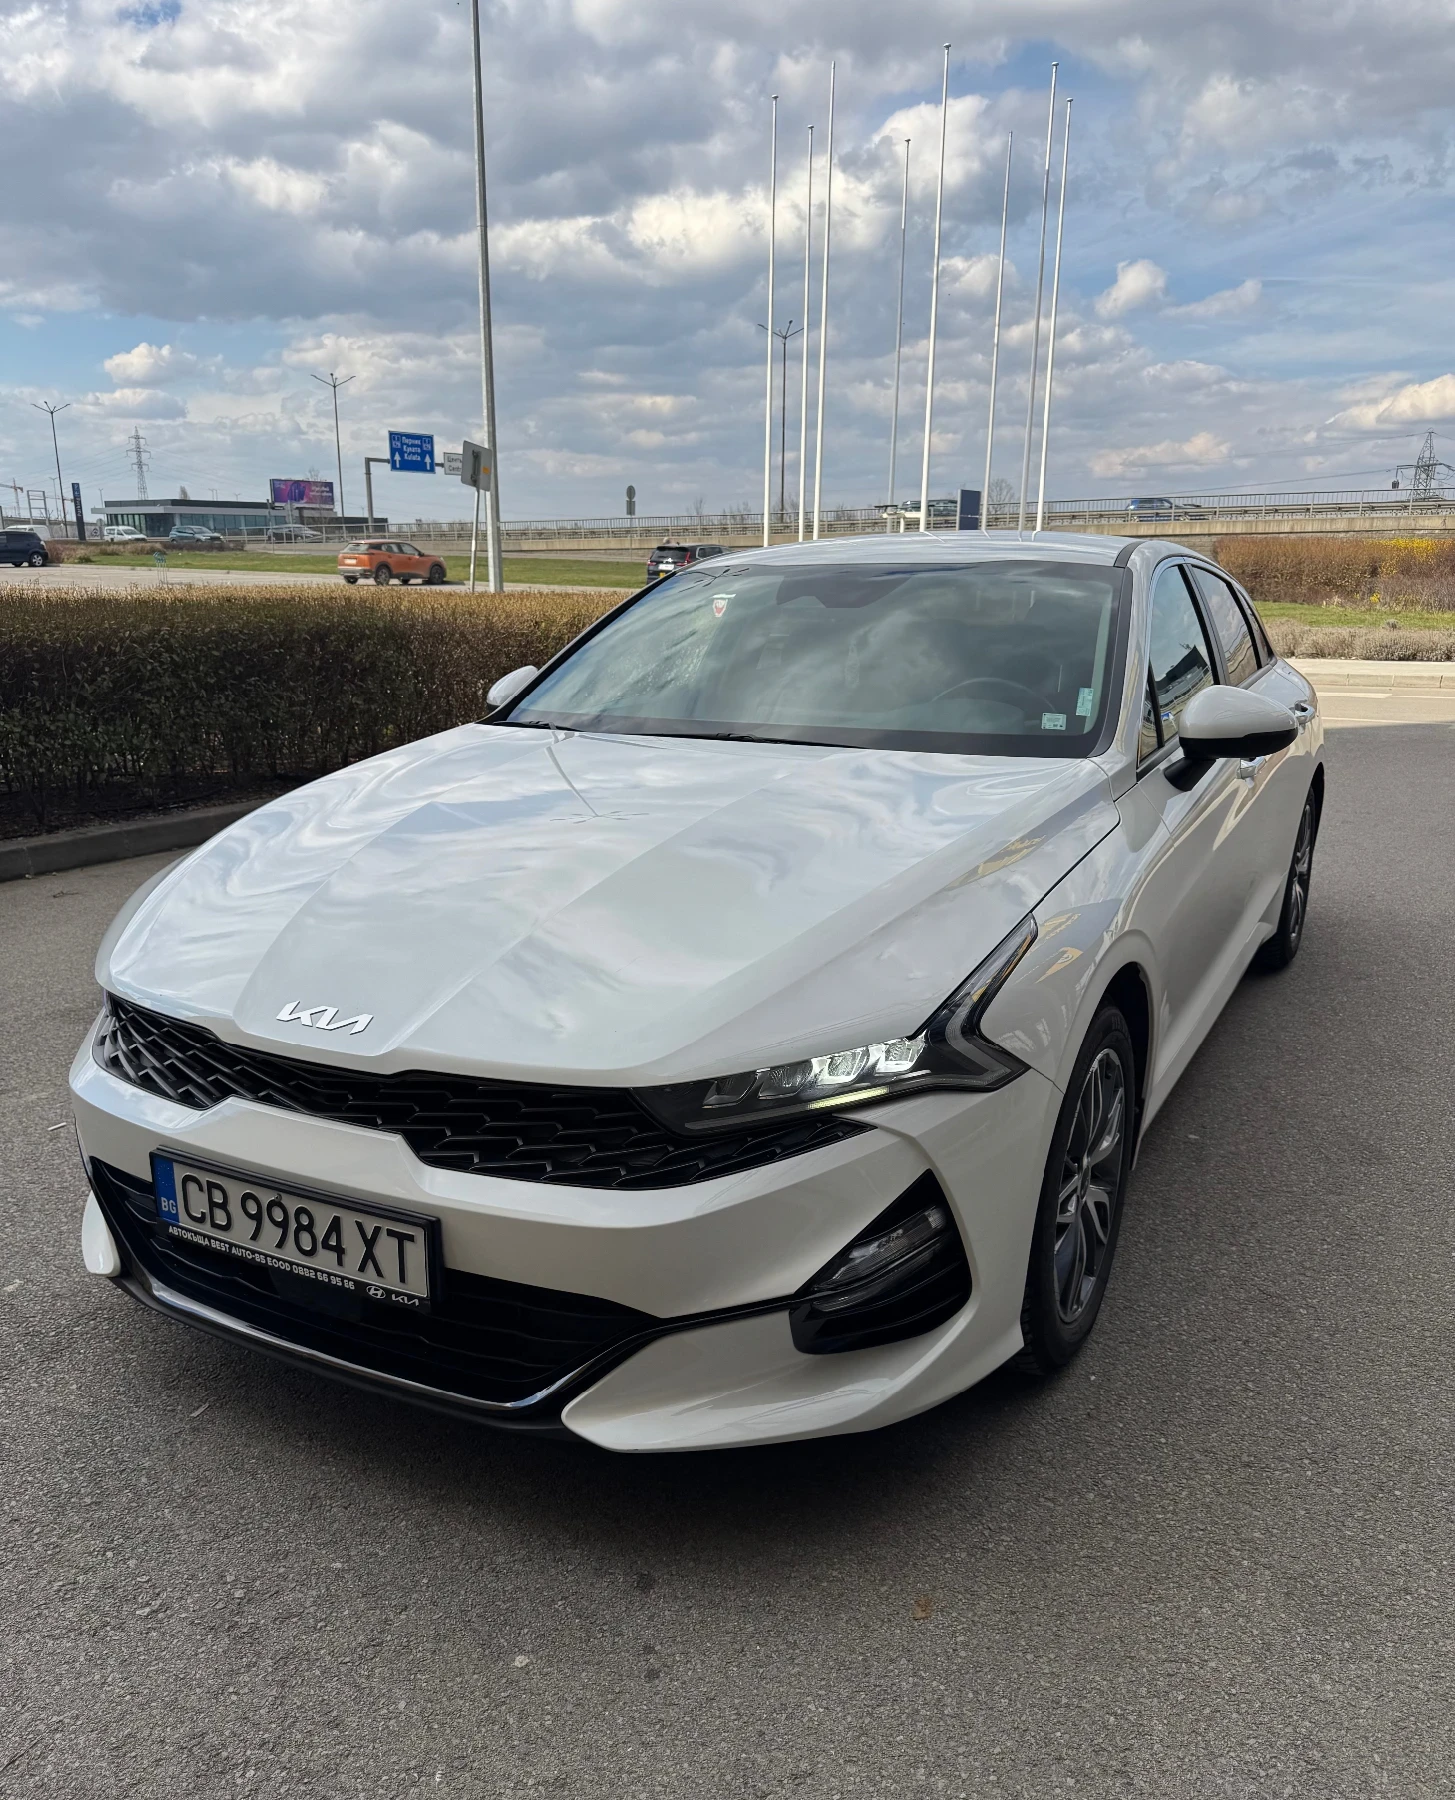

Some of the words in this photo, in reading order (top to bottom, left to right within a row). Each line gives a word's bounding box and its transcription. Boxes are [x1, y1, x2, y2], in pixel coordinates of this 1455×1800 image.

[402, 437, 421, 445] Перник
[403, 445, 421, 453] Кулата
[161, 1197, 177, 1214] BG
[240, 1190, 346, 1267] 9984
[168, 1225, 210, 1246] АВТОКЪЩА
[211, 1240, 230, 1252] BEST
[292, 1264, 316, 1279] 0882
